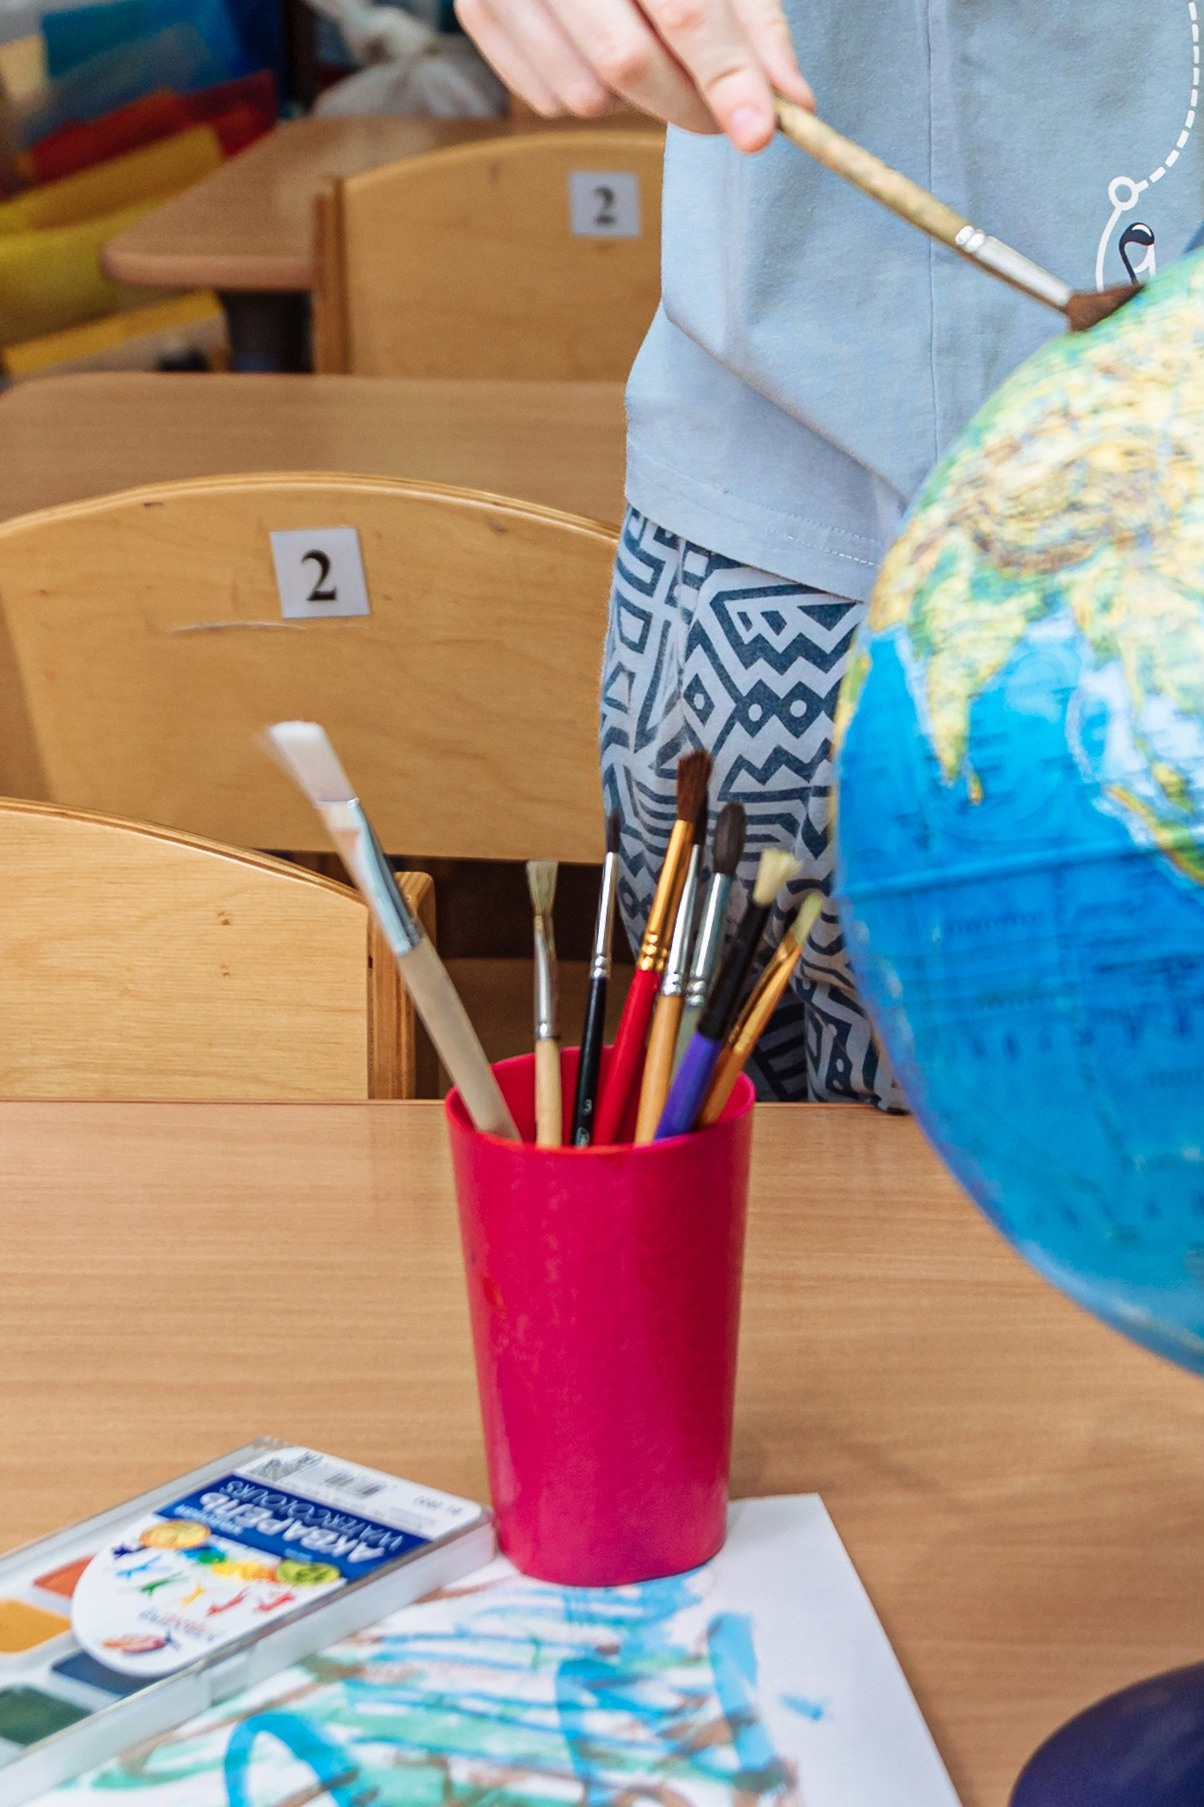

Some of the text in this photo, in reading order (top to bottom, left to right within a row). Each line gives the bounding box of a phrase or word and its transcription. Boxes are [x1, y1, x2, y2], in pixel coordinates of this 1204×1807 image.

[593, 184, 617, 227] 2
[301, 549, 338, 602] 2
[200, 1492, 385, 1564] АКВАРЕЛЬ
